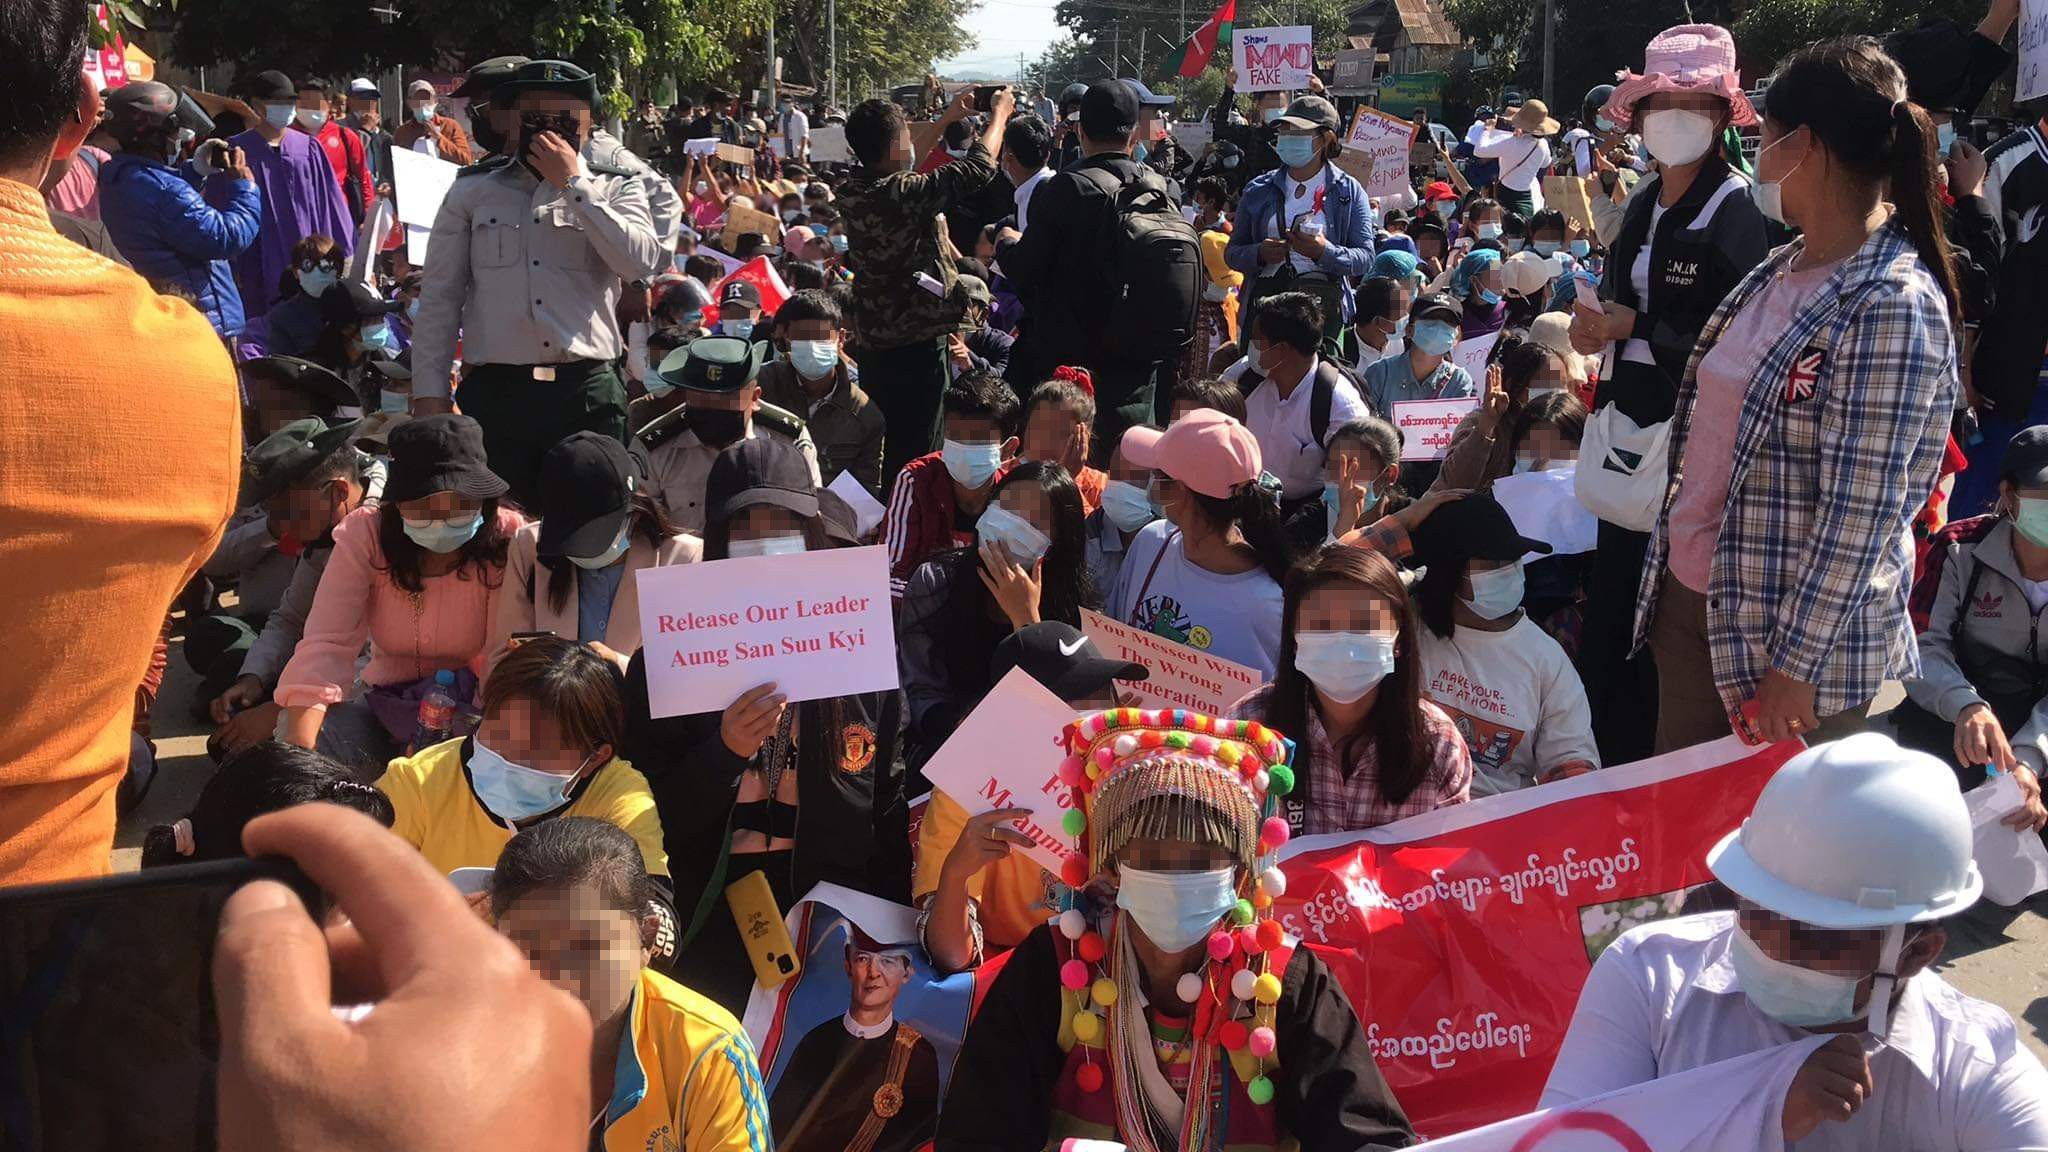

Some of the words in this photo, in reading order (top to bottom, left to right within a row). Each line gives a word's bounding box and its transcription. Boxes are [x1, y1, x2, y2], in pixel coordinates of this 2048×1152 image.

[1250, 69, 1281, 85] FAKE
[658, 611, 739, 633] Release
[746, 605, 788, 624] Our
[796, 596, 869, 618] Leader
[671, 649, 729, 668] Aung
[735, 641, 775, 661] San
[781, 635, 821, 655] Suu
[829, 628, 865, 653] Kyi
[1088, 615, 1125, 638] You
[1132, 632, 1198, 665] Messed
[1205, 658, 1251, 684] With
[1118, 645, 1153, 667] The
[1159, 659, 1223, 696] Wrong
[1439, 670, 1469, 689] MAKE
[1456, 690, 1471, 701] AT
